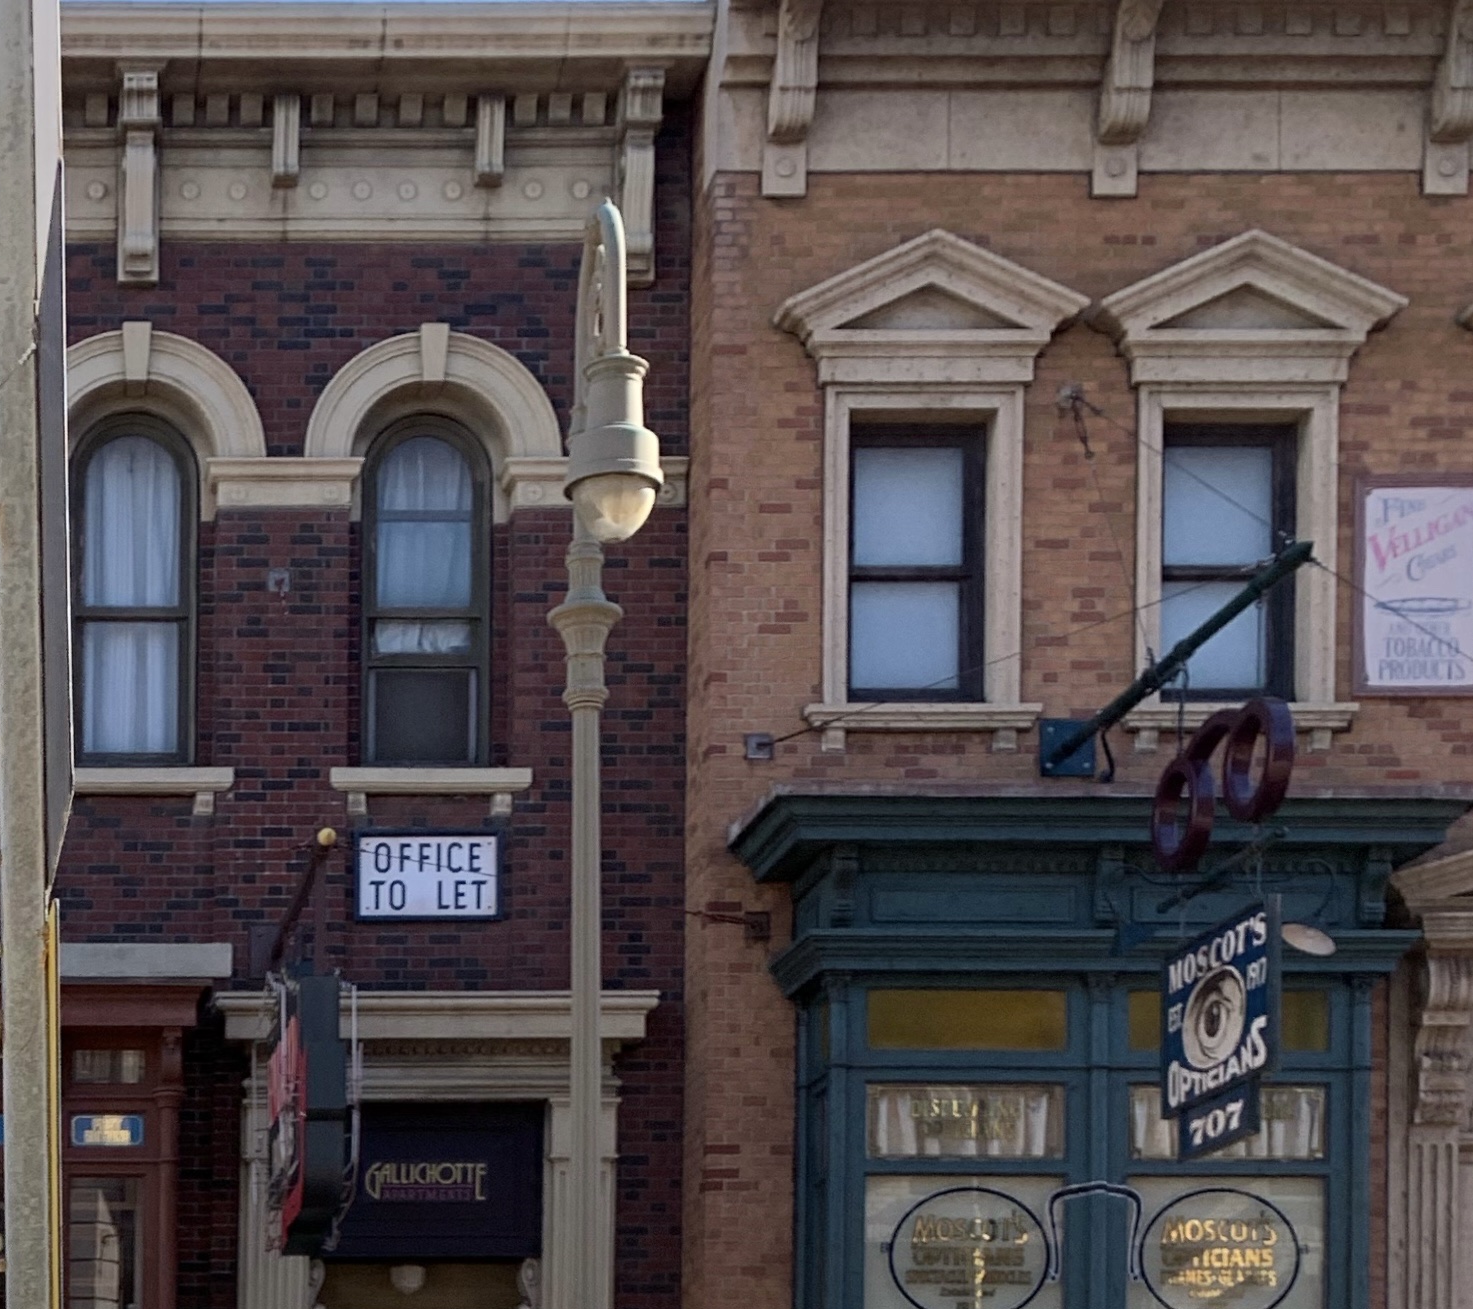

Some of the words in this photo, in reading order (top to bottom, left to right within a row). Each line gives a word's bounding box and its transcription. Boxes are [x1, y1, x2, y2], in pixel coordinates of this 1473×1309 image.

[1385, 636, 1460, 658] TOBACCO
[1379, 659, 1466, 681] PRODUCTS
[375, 842, 482, 873] OFFICE
[369, 880, 406, 911] TO
[437, 880, 487, 910] LET
[1169, 912, 1267, 994] MOSCOT'S
[1168, 1015, 1268, 1108] OPTICIANS
[1189, 1099, 1244, 1146] 707
